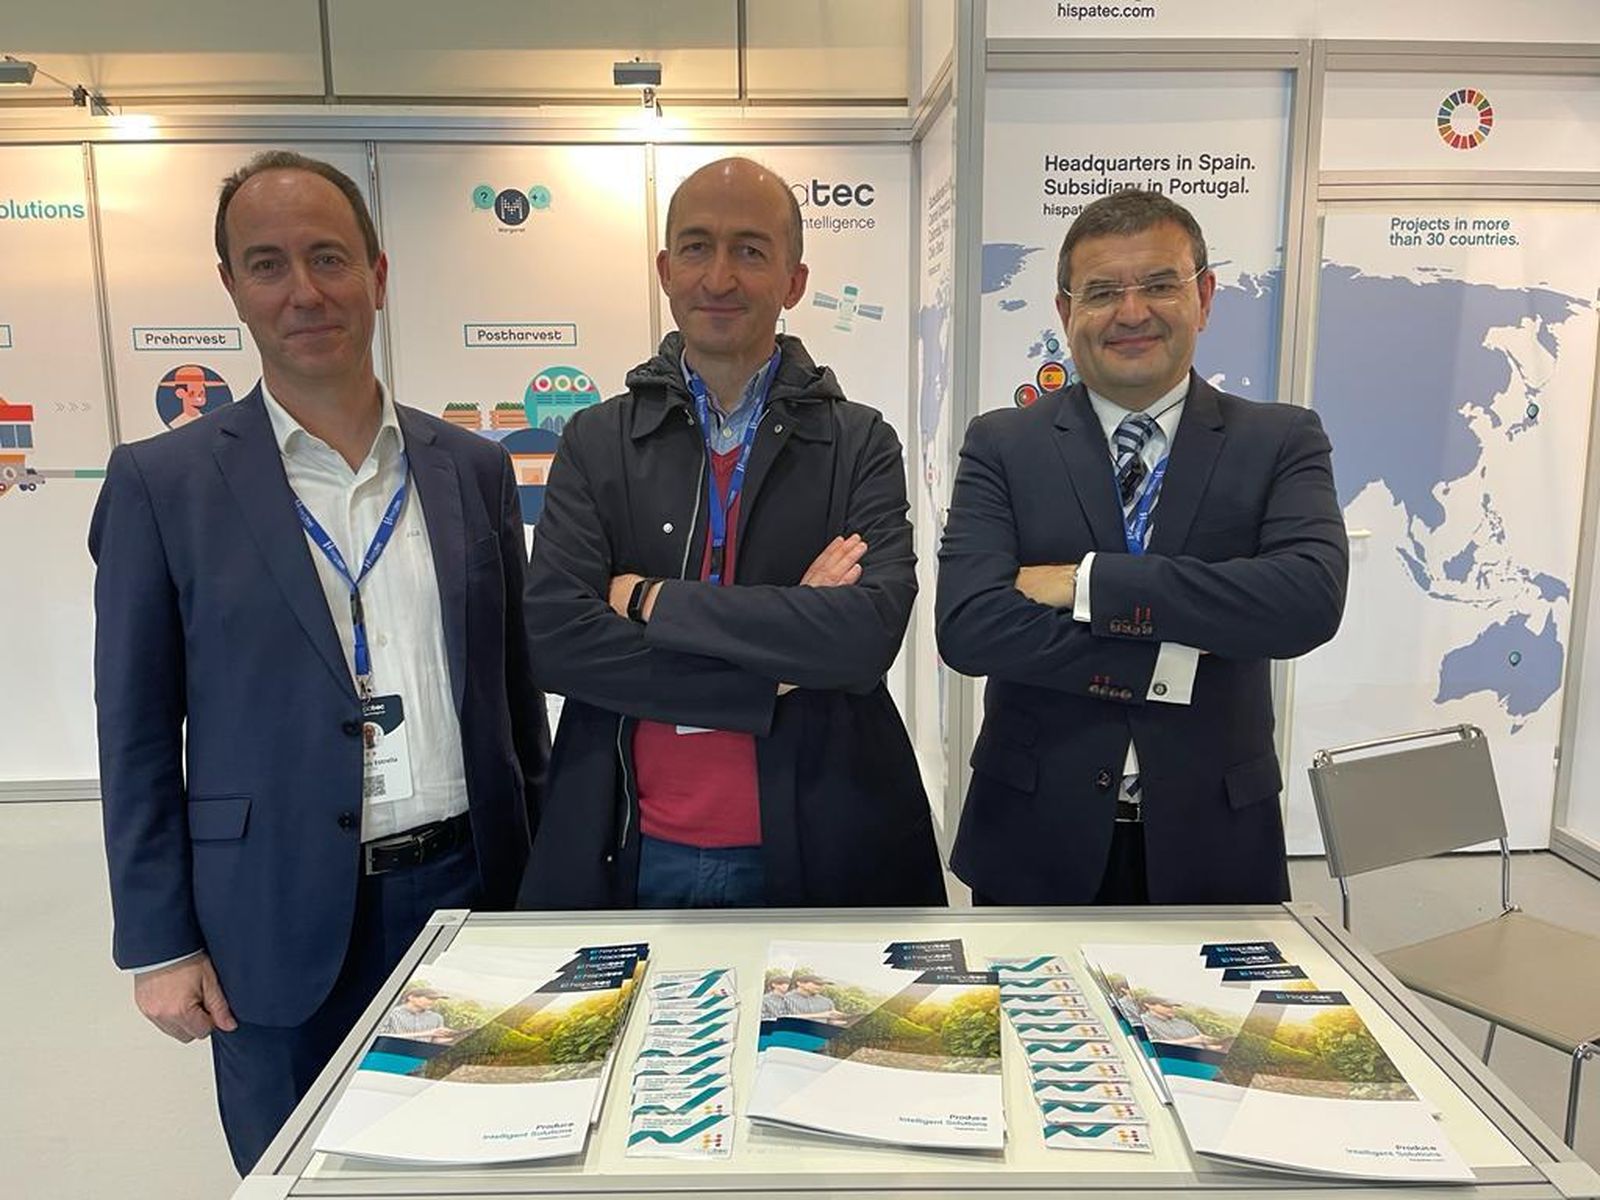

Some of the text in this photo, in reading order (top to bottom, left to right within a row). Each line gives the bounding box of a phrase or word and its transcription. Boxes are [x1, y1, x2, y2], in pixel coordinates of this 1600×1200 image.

[1057, 3, 1155, 20] hispatec.com
[1044, 154, 1255, 175] Headquarters in Spain.
[1148, 179, 1163, 193] in
[1169, 177, 1249, 198] Portugal.
[0, 199, 85, 219] olutions
[1390, 217, 1510, 234] Projects in more
[1390, 232, 1520, 246] than 30 countries.
[145, 333, 226, 345] Preharvest
[477, 329, 562, 341] Postharvest
